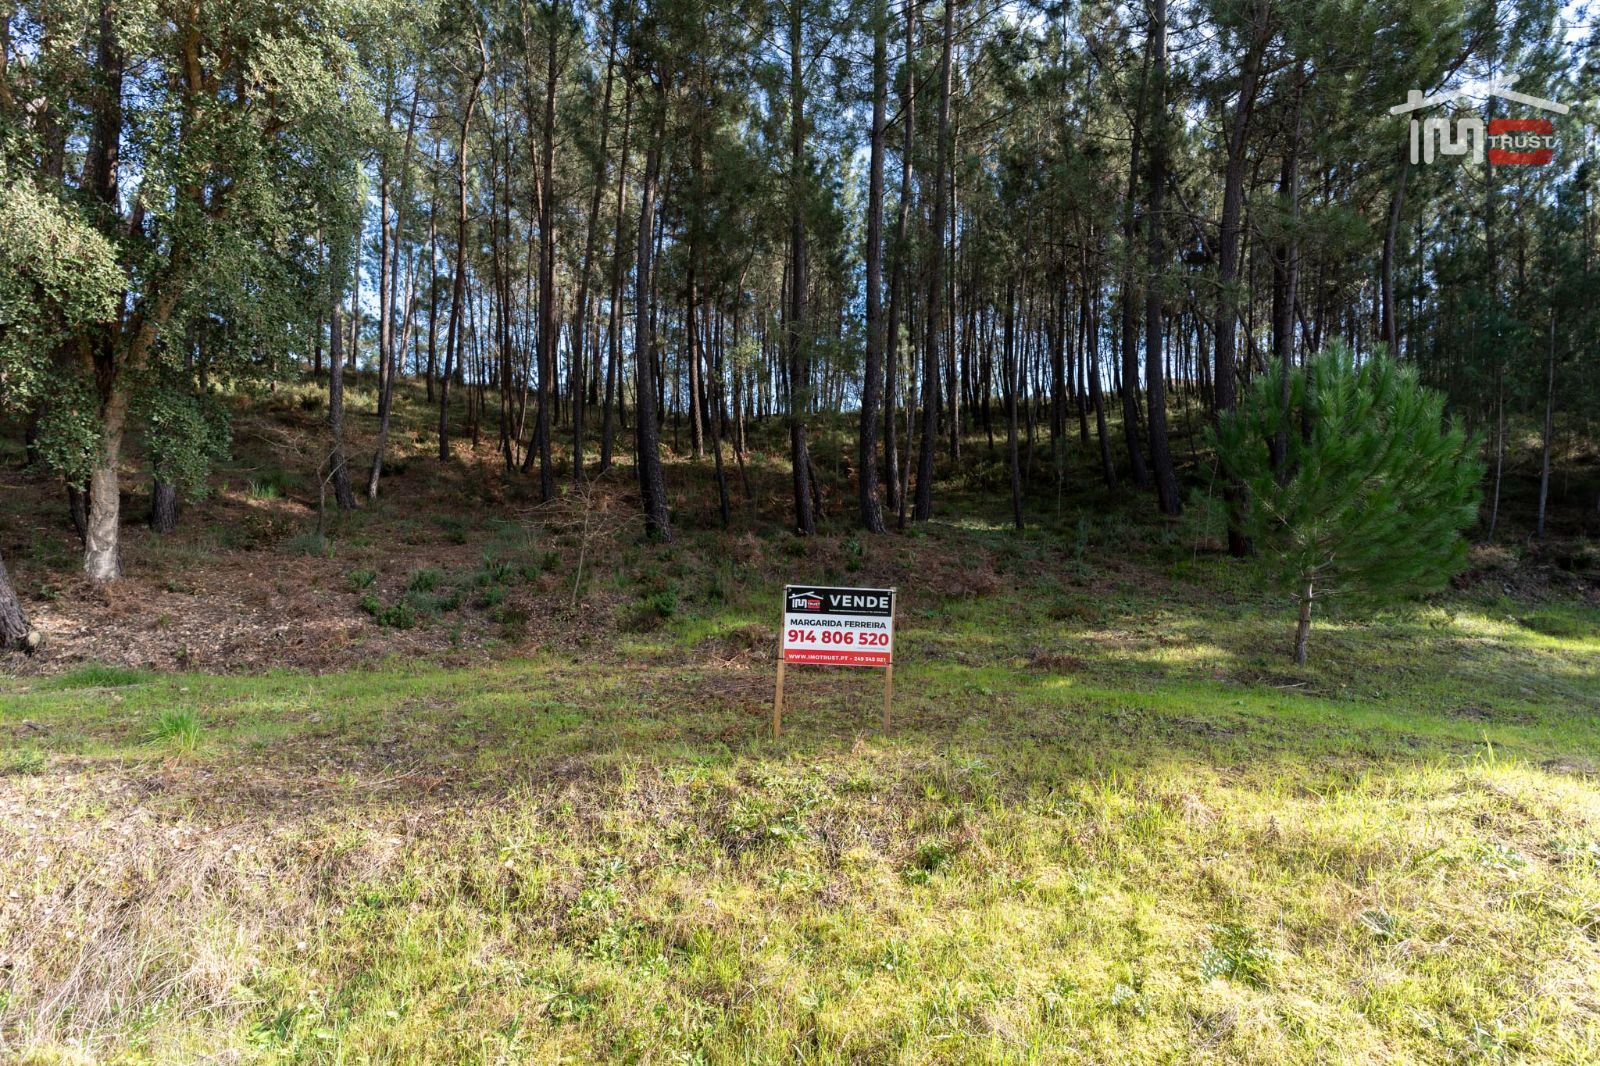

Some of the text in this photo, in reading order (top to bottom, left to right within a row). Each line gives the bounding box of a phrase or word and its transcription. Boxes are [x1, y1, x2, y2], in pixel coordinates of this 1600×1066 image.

[829, 594, 889, 609] VENDE
[790, 618, 886, 629] MARGARIDA FERREIRA
[788, 629, 889, 646] 914 806 520
